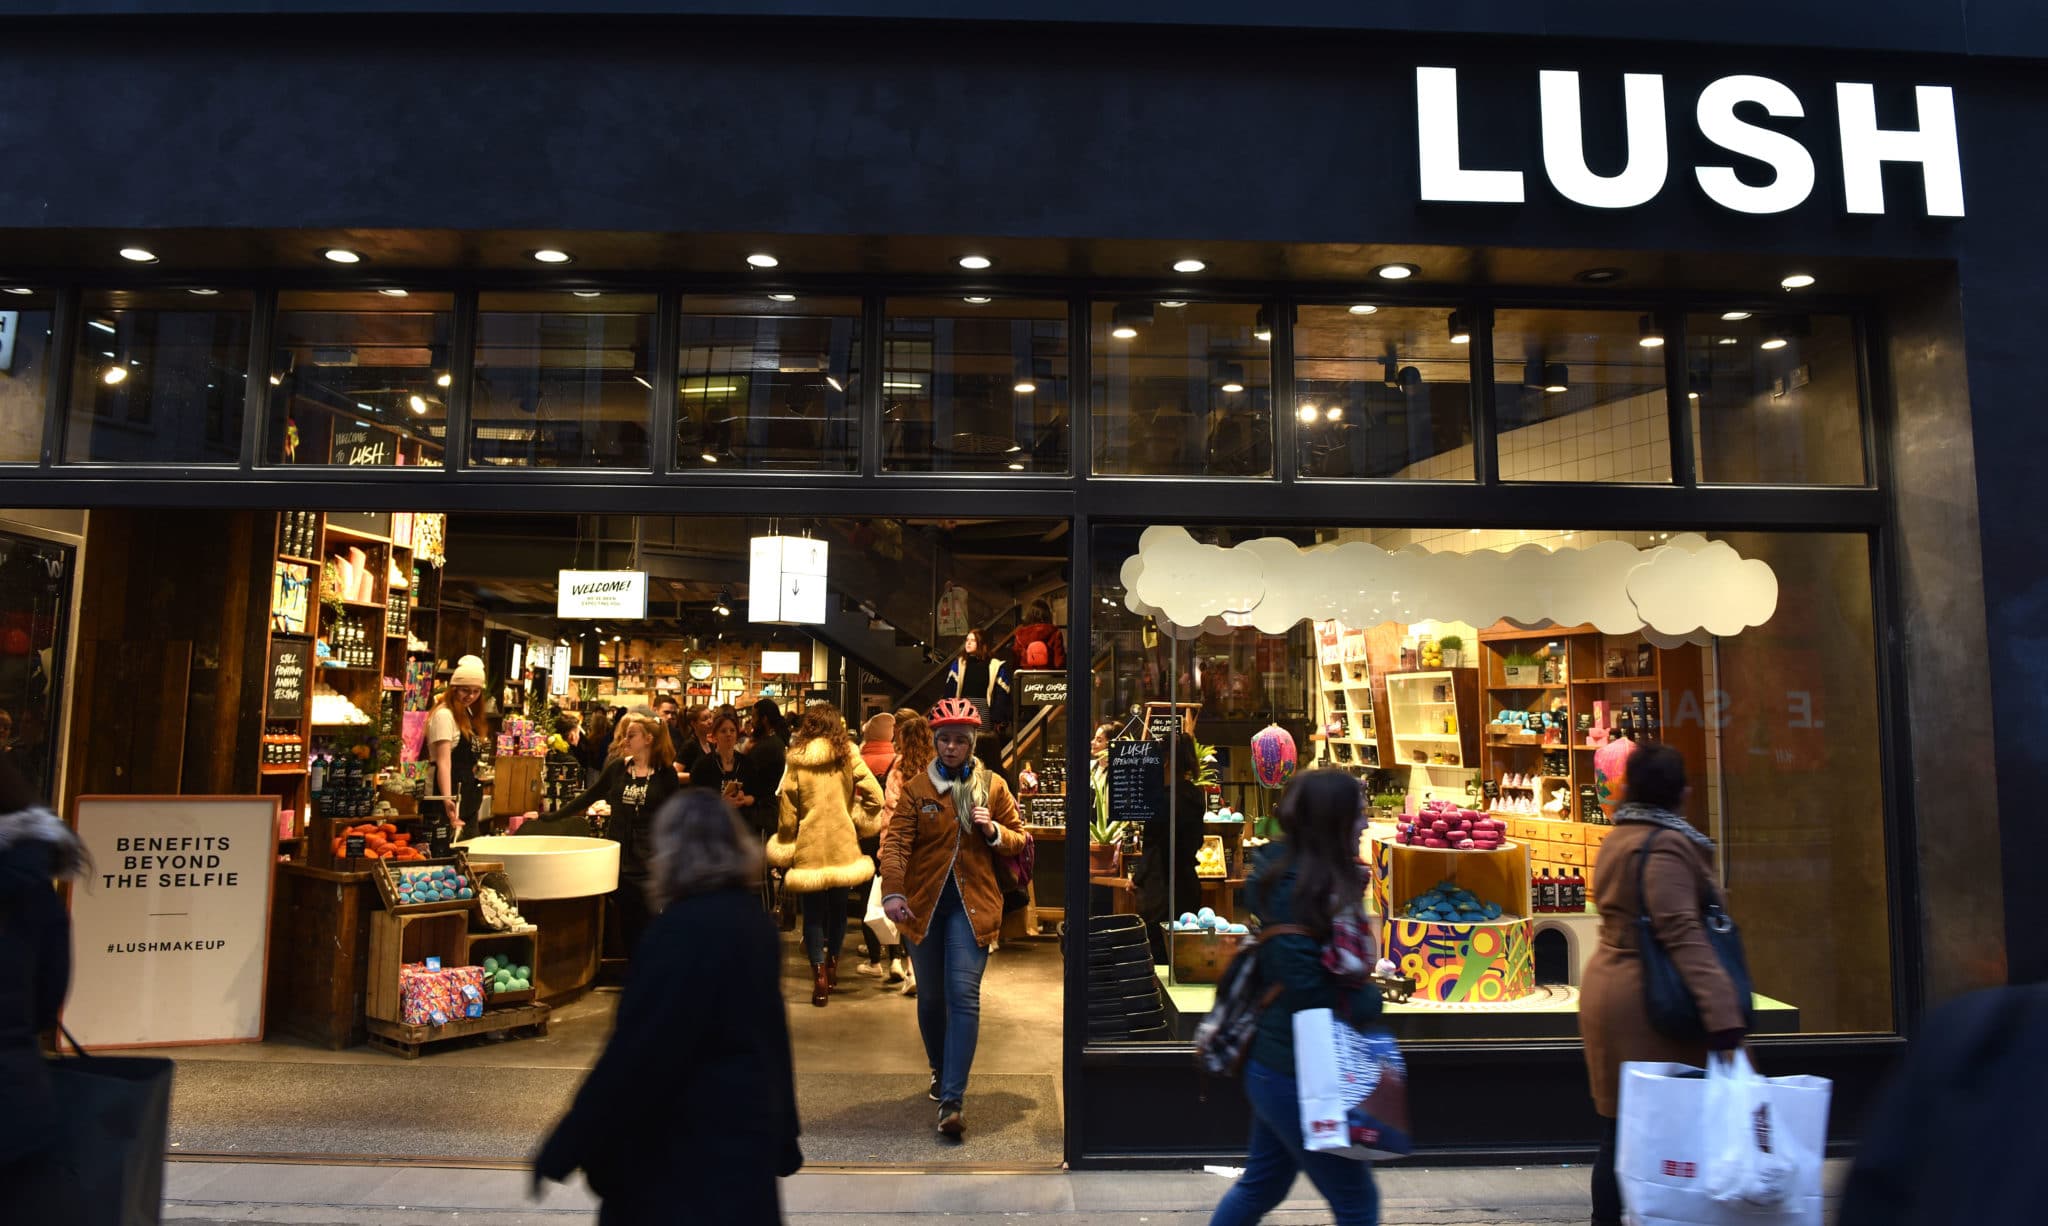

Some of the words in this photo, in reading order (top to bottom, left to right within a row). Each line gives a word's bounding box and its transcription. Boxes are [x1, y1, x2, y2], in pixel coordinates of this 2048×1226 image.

[1416, 66, 1965, 217] LUSH
[572, 580, 632, 596] WELCOME!
[1120, 743, 1152, 756] LUSH
[117, 837, 230, 851] BENEFITS
[124, 855, 220, 869] BEYOND
[103, 874, 147, 888] THE
[159, 872, 238, 887] SELFIE
[107, 940, 225, 953] #LUSHMAKEUP
